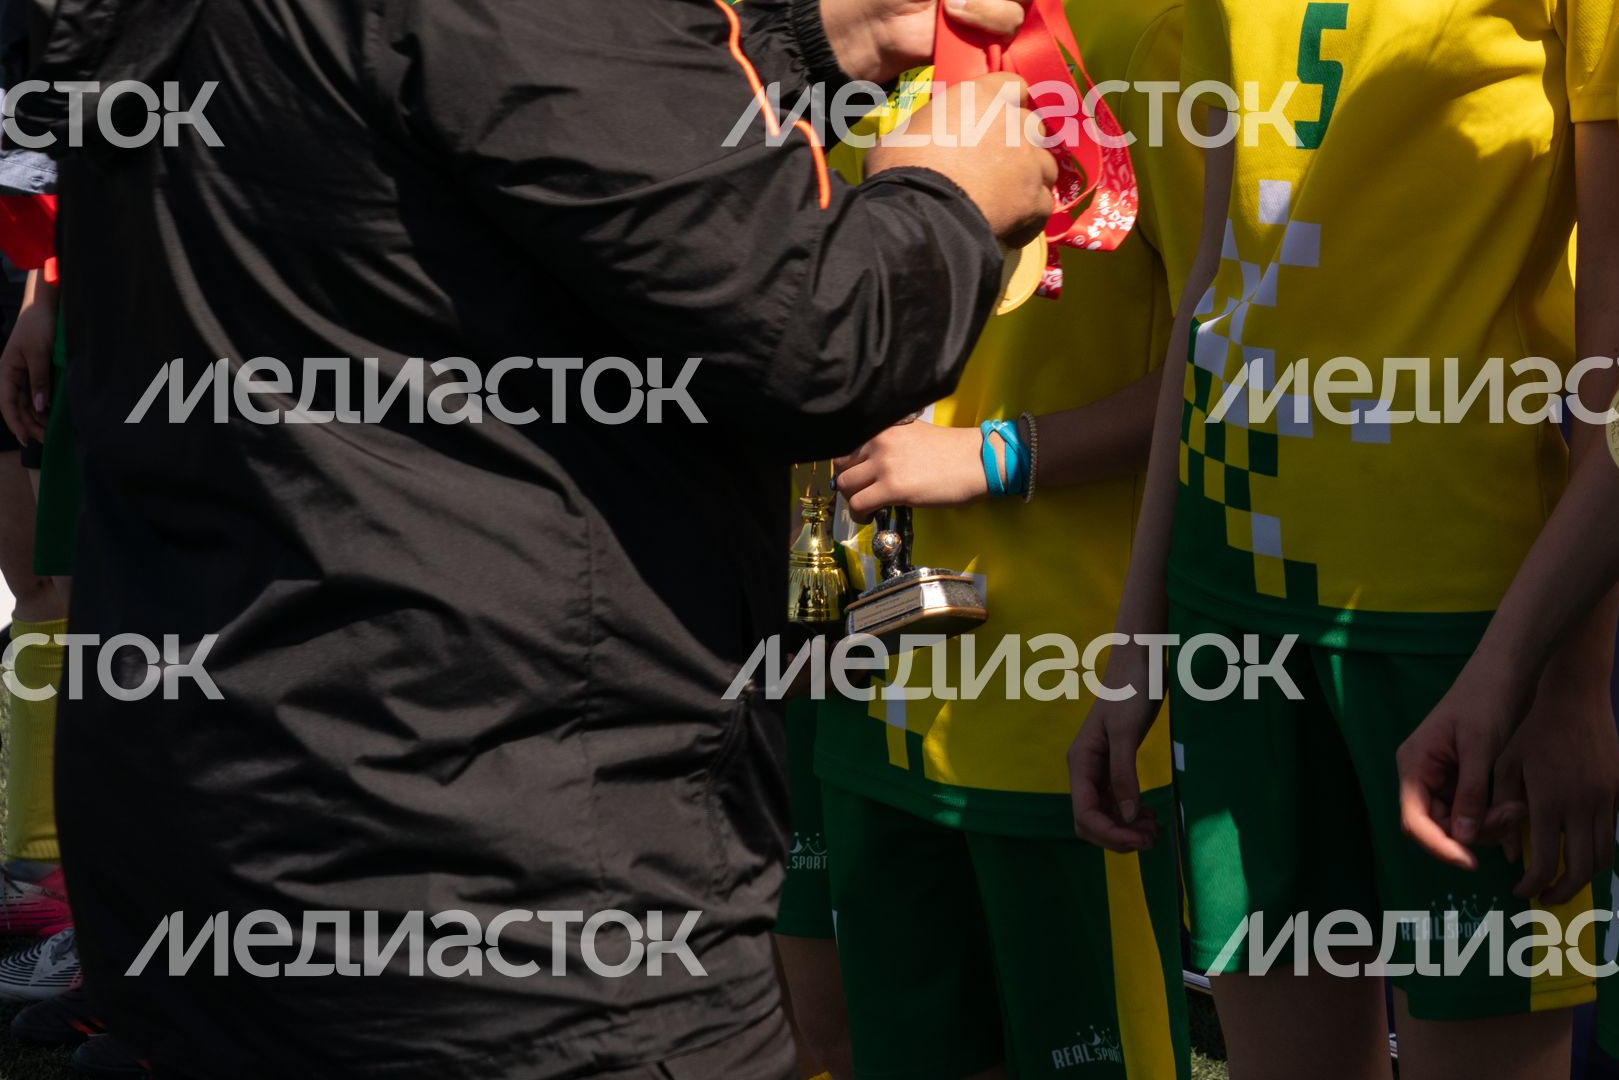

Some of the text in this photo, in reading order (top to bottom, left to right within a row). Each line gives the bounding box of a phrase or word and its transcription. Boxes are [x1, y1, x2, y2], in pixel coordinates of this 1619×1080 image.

[1294, 2, 1349, 150] 5
[791, 855, 828, 870] SPORT
[1052, 1043, 1095, 1070] REAL
